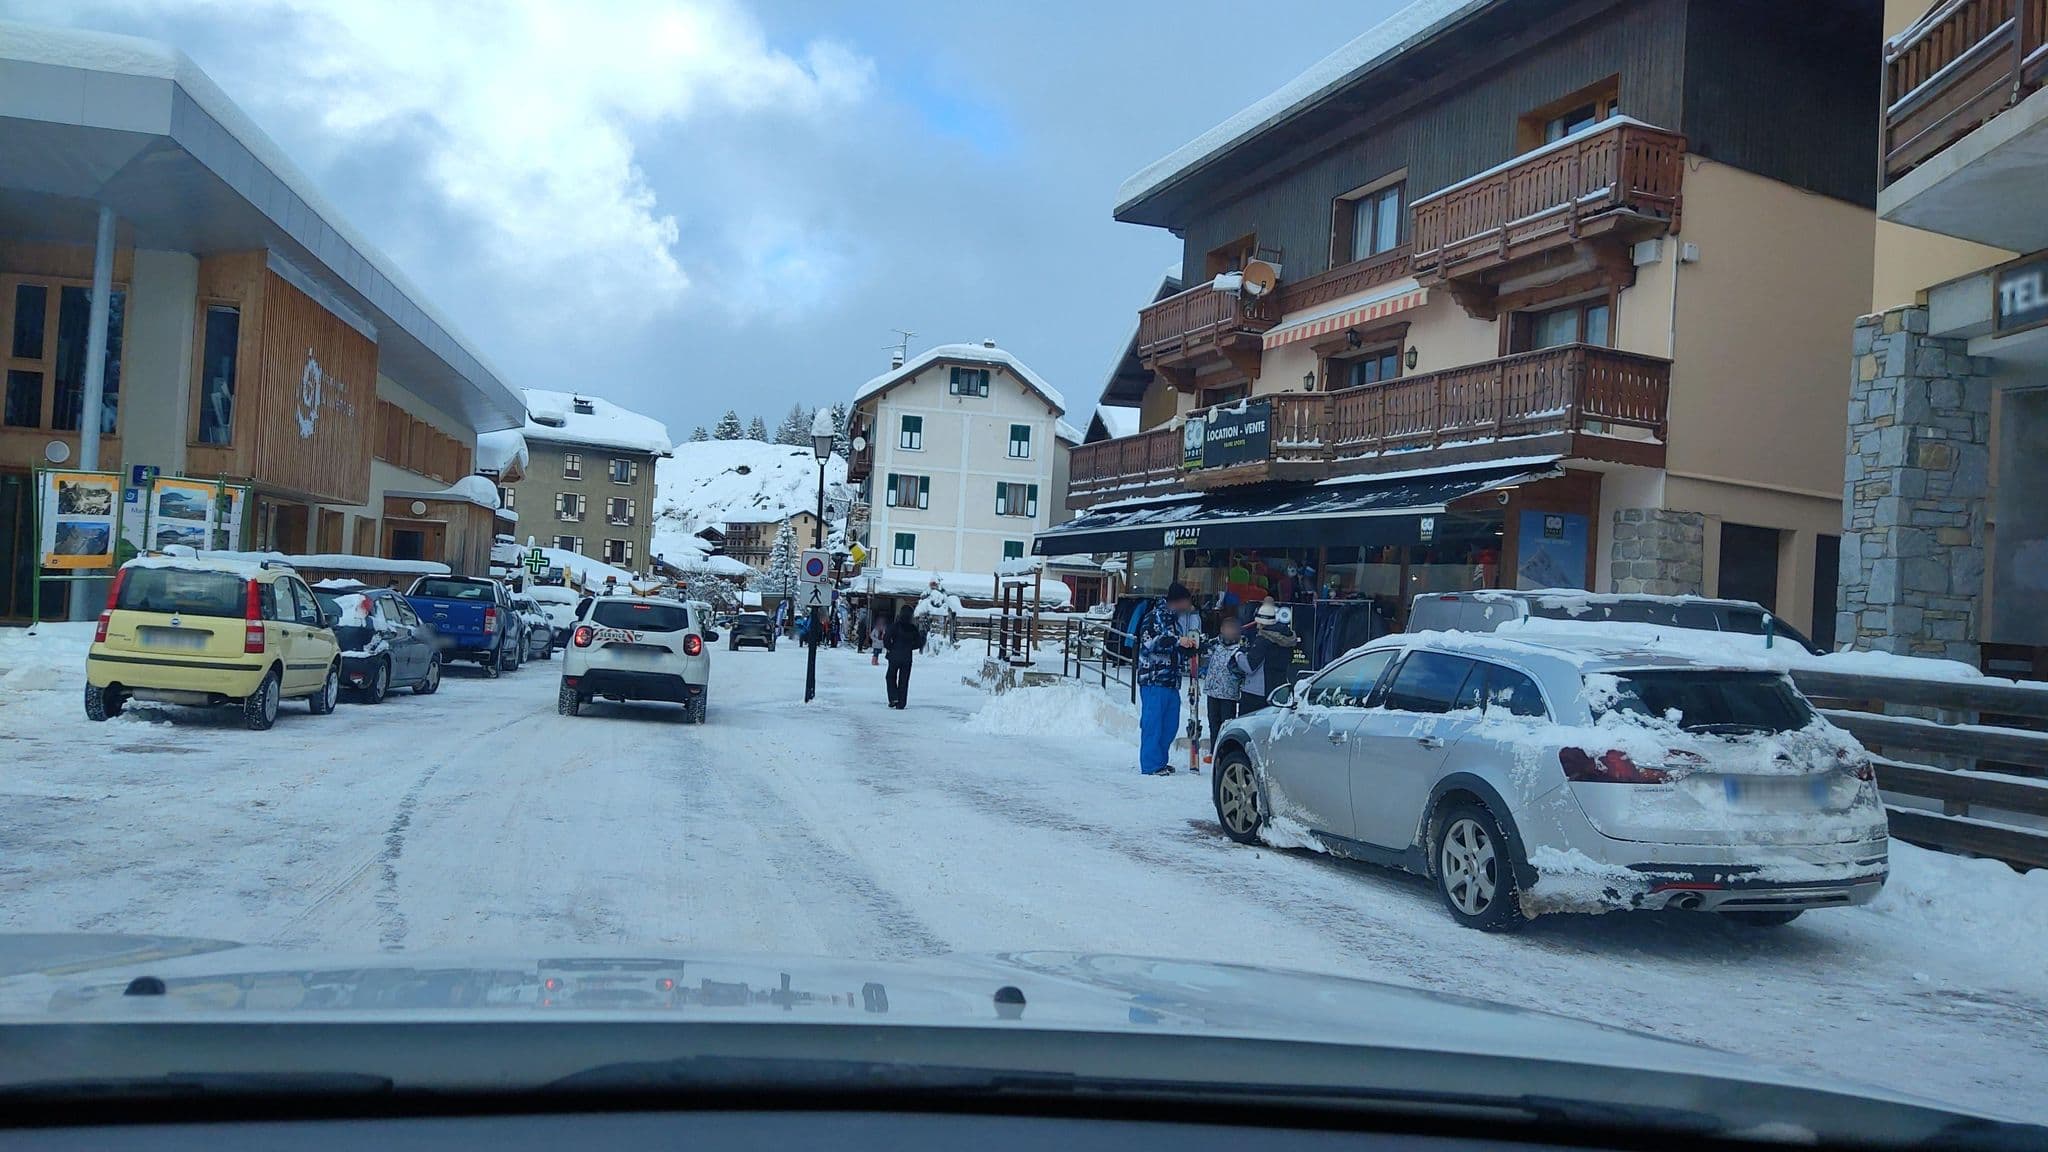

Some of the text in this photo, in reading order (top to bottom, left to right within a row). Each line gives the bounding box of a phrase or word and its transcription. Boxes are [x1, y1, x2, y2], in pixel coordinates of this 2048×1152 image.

[1207, 425, 1239, 441] LOCATION
[1244, 421, 1265, 435] VENTE
[1164, 527, 1201, 546] GO SPORT
[600, 631, 626, 639] SERVICE
